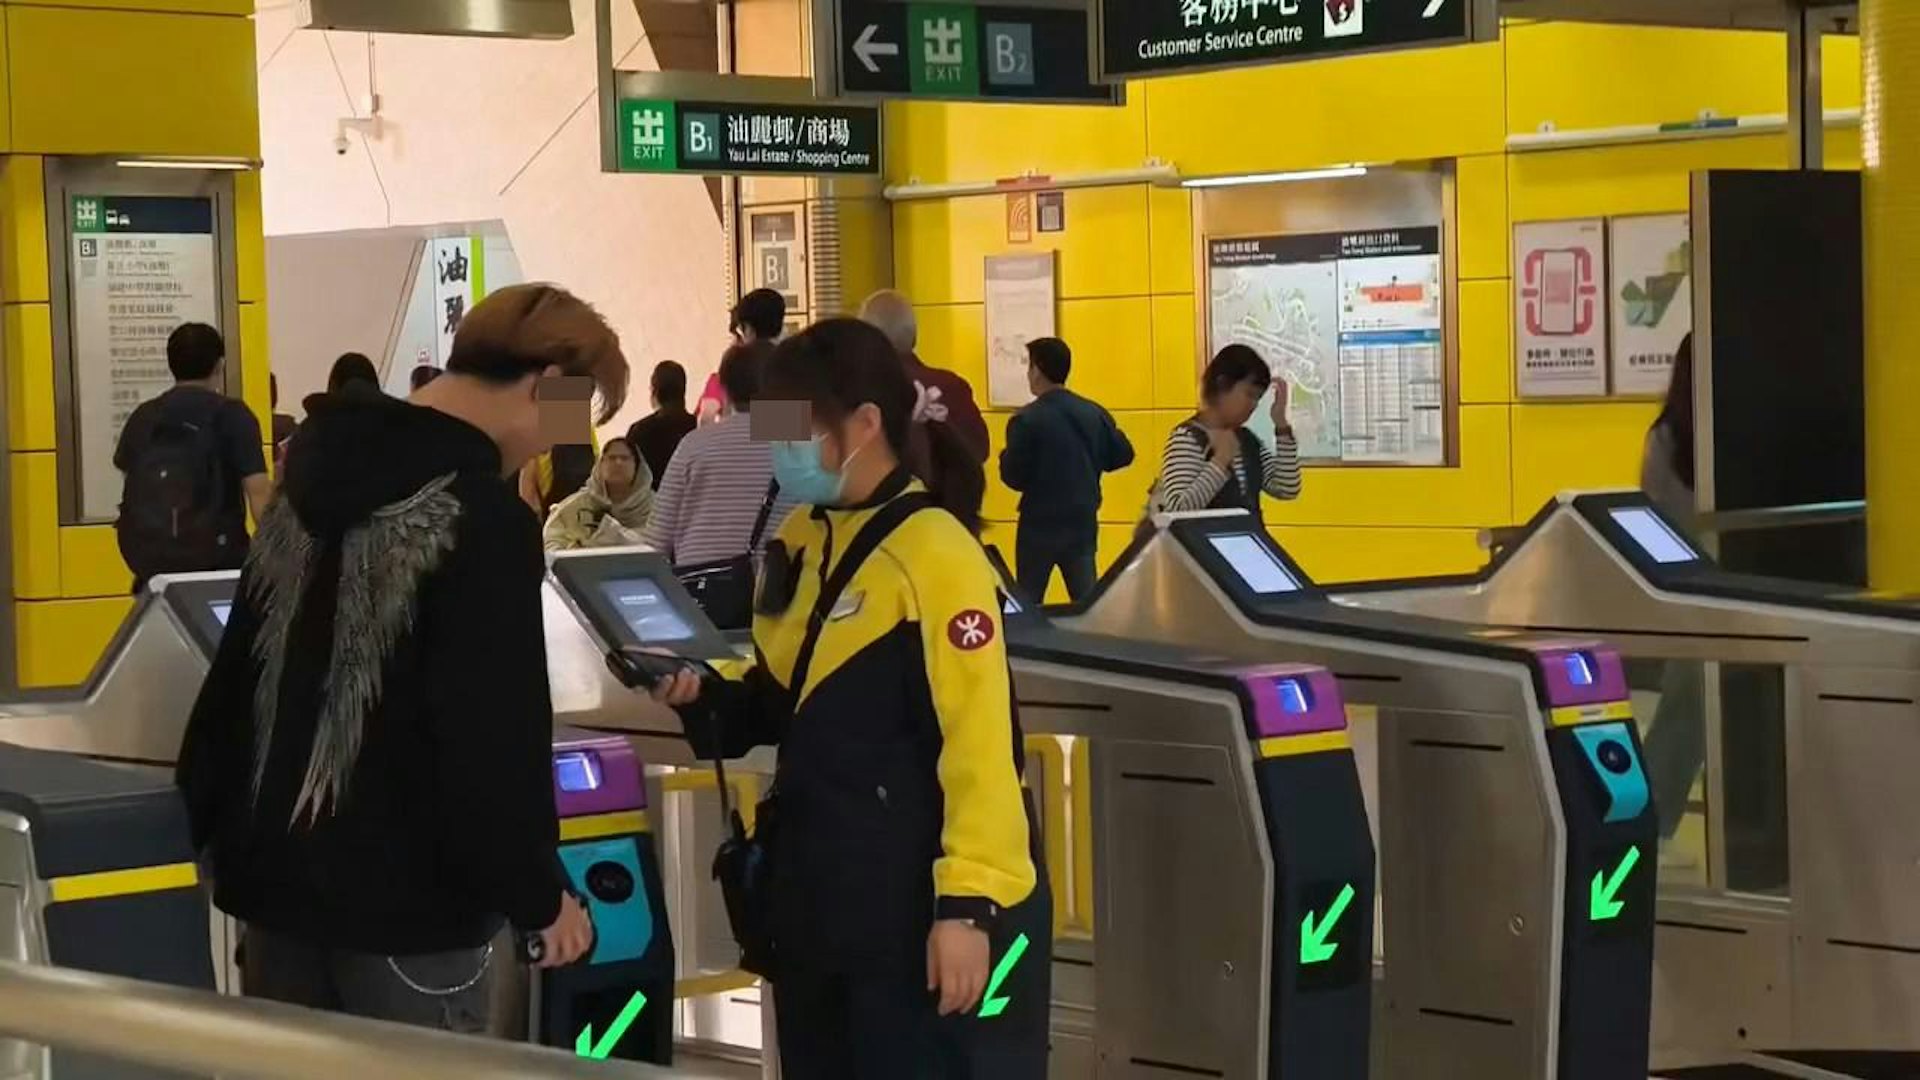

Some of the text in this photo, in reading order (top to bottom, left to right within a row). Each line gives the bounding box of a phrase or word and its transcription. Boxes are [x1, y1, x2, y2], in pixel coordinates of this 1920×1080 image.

[995, 33, 1028, 74] B2
[1138, 25, 1303, 60] Customer Service Centre
[925, 65, 962, 82] EXIT
[690, 120, 713, 153] B1
[633, 146, 664, 160] EXIT
[728, 147, 745, 162] Yau
[747, 148, 760, 162] Lai
[761, 149, 790, 164] Estate
[796, 150, 840, 167] Shopping
[841, 151, 870, 166] Centre
